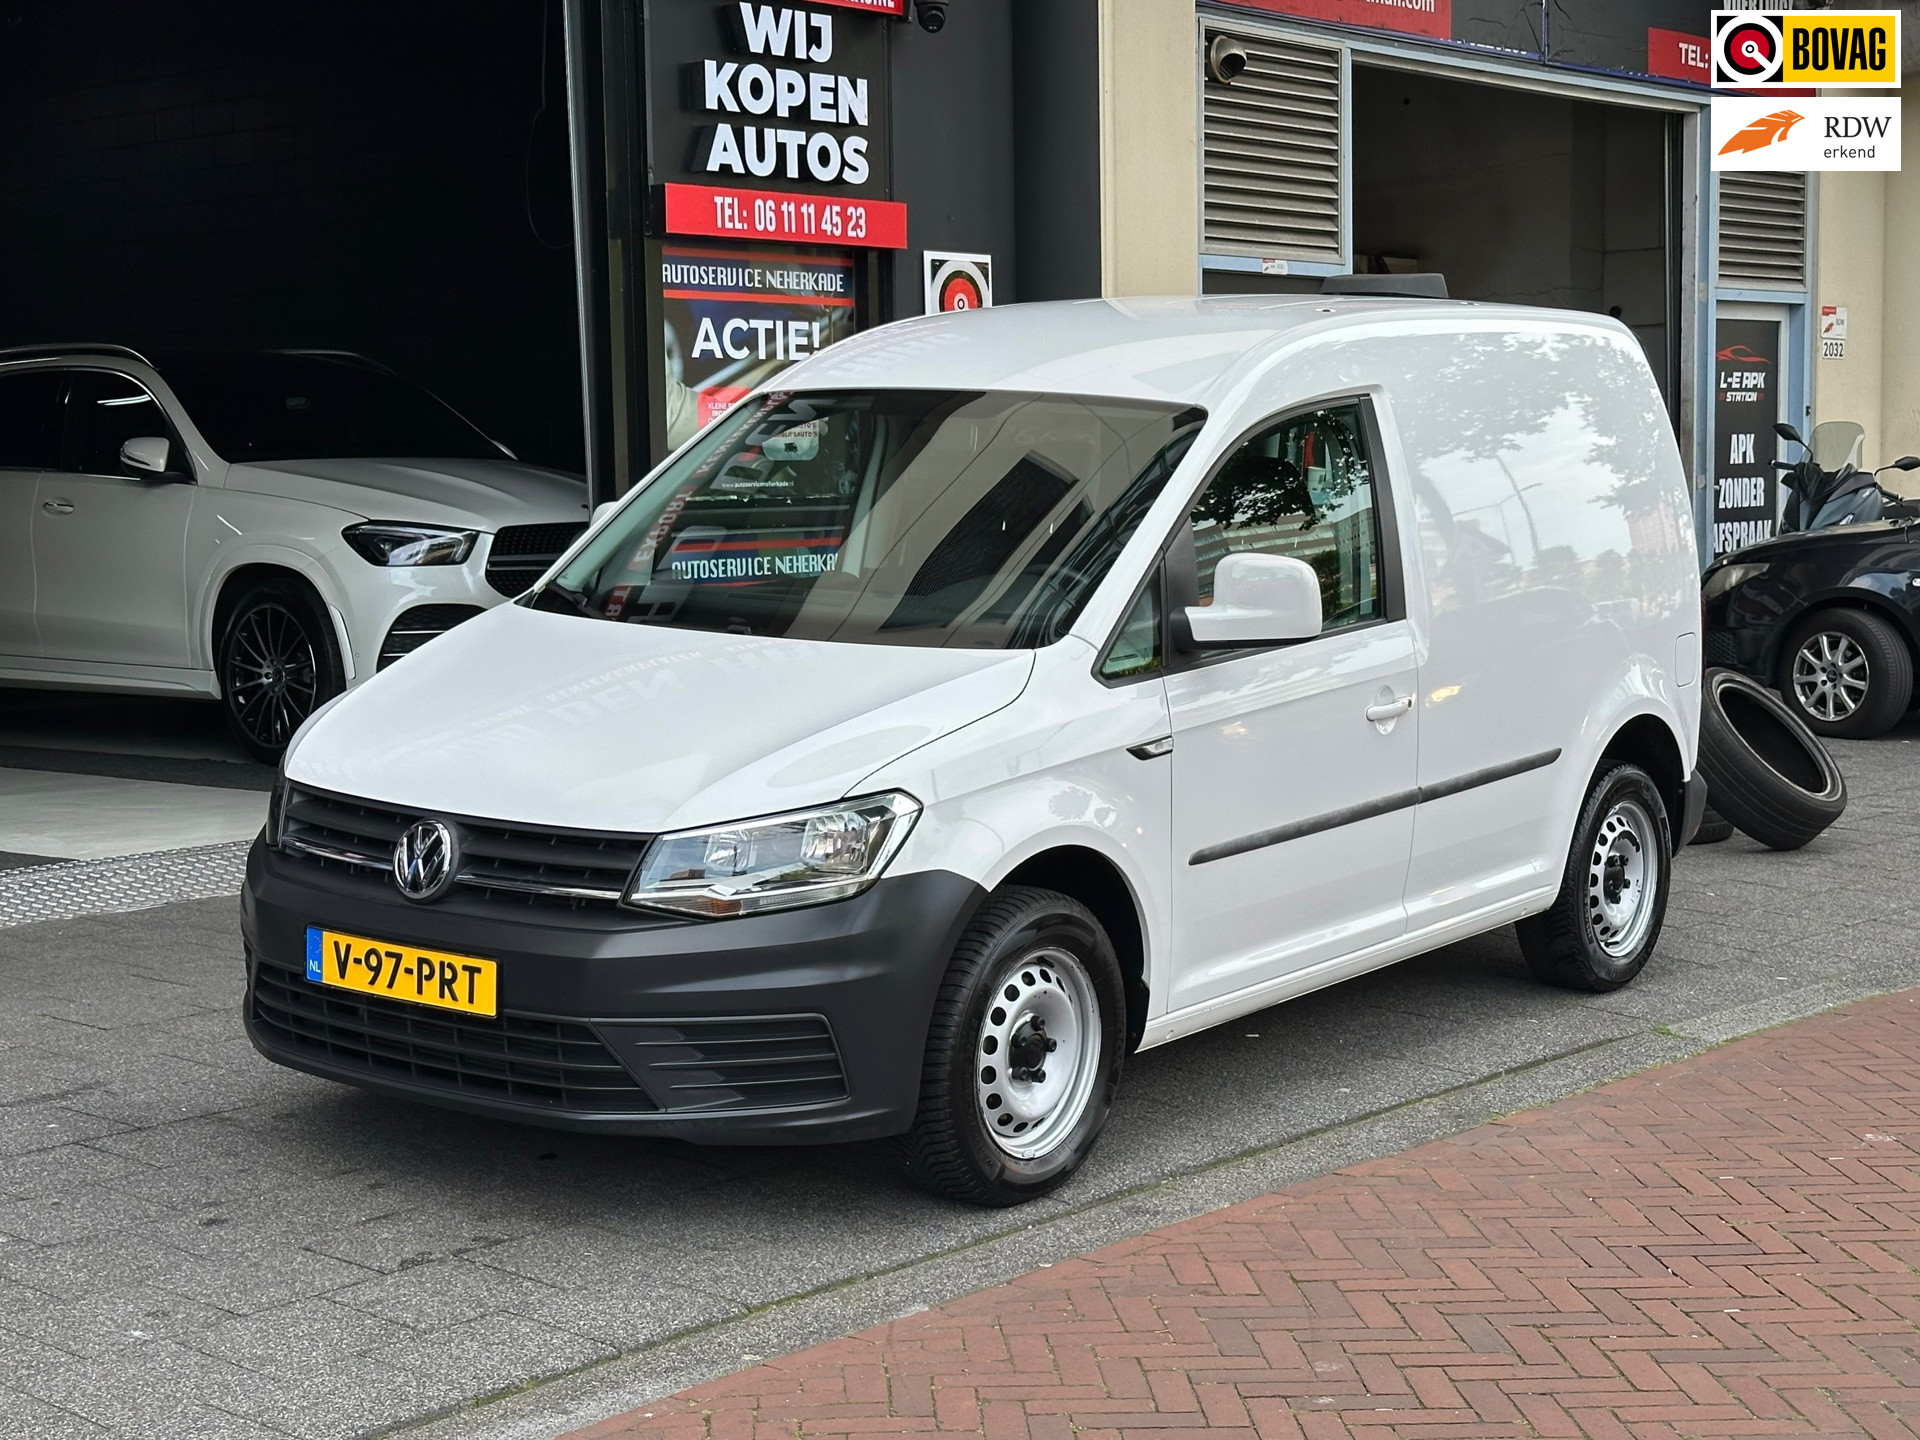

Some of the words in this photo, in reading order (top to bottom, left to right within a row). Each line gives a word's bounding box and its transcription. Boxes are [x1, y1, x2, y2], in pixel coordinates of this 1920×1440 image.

[739, 1, 833, 63] WIJ
[1678, 42, 1709, 69] TEL:
[704, 59, 869, 126] KOPEN
[706, 123, 870, 185] AUTOS
[714, 196, 748, 230] TEL:
[754, 199, 776, 232] 06
[781, 202, 796, 234] 11
[801, 203, 816, 235] 11
[821, 205, 842, 237] 45
[846, 206, 867, 239] 23
[662, 263, 762, 288] AUTOSERVICE
[766, 270, 844, 293] NEHERKADE
[692, 317, 820, 361] ACTIE!
[1823, 342, 1844, 357] 2032
[1742, 372, 1766, 388] APK
[1726, 392, 1757, 402] STATION
[1730, 434, 1755, 464] APK
[1719, 477, 1765, 509] ZONDER
[309, 959, 321, 973] NL
[333, 940, 482, 1004] V-97-PRT
